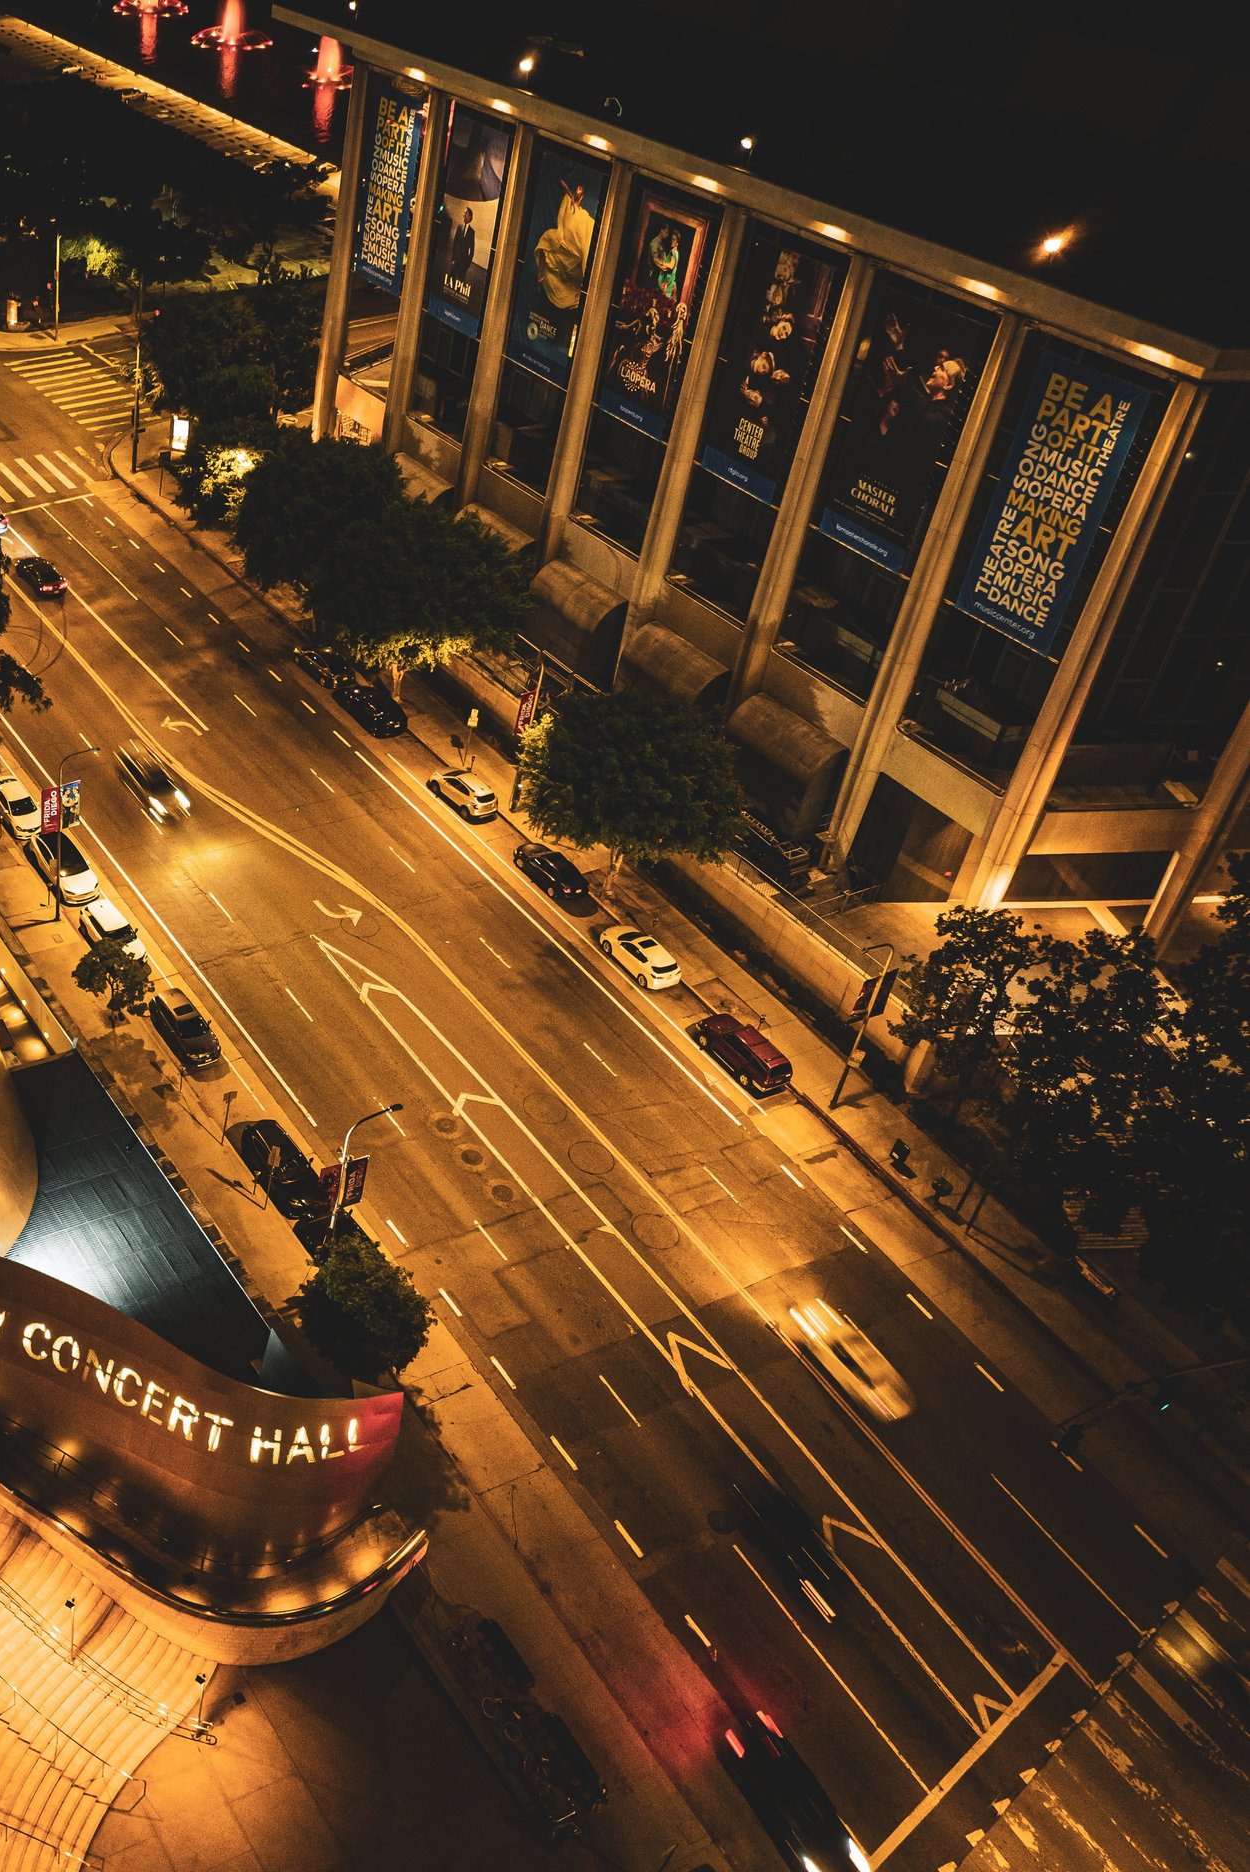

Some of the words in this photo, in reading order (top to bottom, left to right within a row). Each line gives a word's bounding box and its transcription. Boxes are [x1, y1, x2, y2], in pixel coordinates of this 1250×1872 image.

[376, 115, 409, 140] PART
[378, 96, 398, 121] BE
[398, 105, 409, 128] A
[381, 136, 395, 150] OF
[395, 141, 406, 157] IT
[404, 108, 417, 157] THEATRE
[370, 132, 382, 182] SONG
[378, 161, 408, 183] DANCE
[379, 148, 409, 170] MUSIC
[368, 182, 403, 208] MAKING
[376, 172, 405, 196] OPERA
[361, 194, 374, 260] THEATRE
[371, 216, 400, 241] SONG
[372, 198, 402, 227] ART
[368, 241, 397, 265] MUSIC
[369, 230, 398, 253] OPERA
[366, 252, 396, 277] DANCE
[454, 279, 472, 297] Phil
[1045, 373, 1088, 411] BE
[1088, 393, 1112, 423] A
[739, 418, 764, 441] CENTER
[1036, 398, 1109, 446] PART
[1095, 400, 1131, 467] THEATRE
[734, 428, 760, 452] THEATRE
[739, 444, 758, 460] GROUP
[1046, 430, 1078, 453] OF
[1078, 442, 1100, 464] IT
[1013, 424, 1047, 492] SONG
[1039, 446, 1103, 487] MUSIC
[858, 480, 897, 506] MASTER
[1028, 480, 1086, 520] OPERA
[1033, 463, 1097, 504] DANCE
[850, 487, 896, 517] CHORALE
[1006, 489, 1082, 536] MAKING
[974, 505, 1017, 594] THEATRE
[1010, 515, 1077, 561] ART
[1003, 539, 1066, 581] SONG
[993, 570, 1053, 612] MUSIC
[999, 556, 1057, 598] OPERA
[973, 600, 1036, 640] musiccenter.org
[987, 586, 1049, 628] DANCE
[43, 799, 51, 823] FRIDA
[50, 790, 58, 816] DIEGO
[22, 1322, 234, 1452] CONCERT
[249, 1417, 371, 1465] HALL
